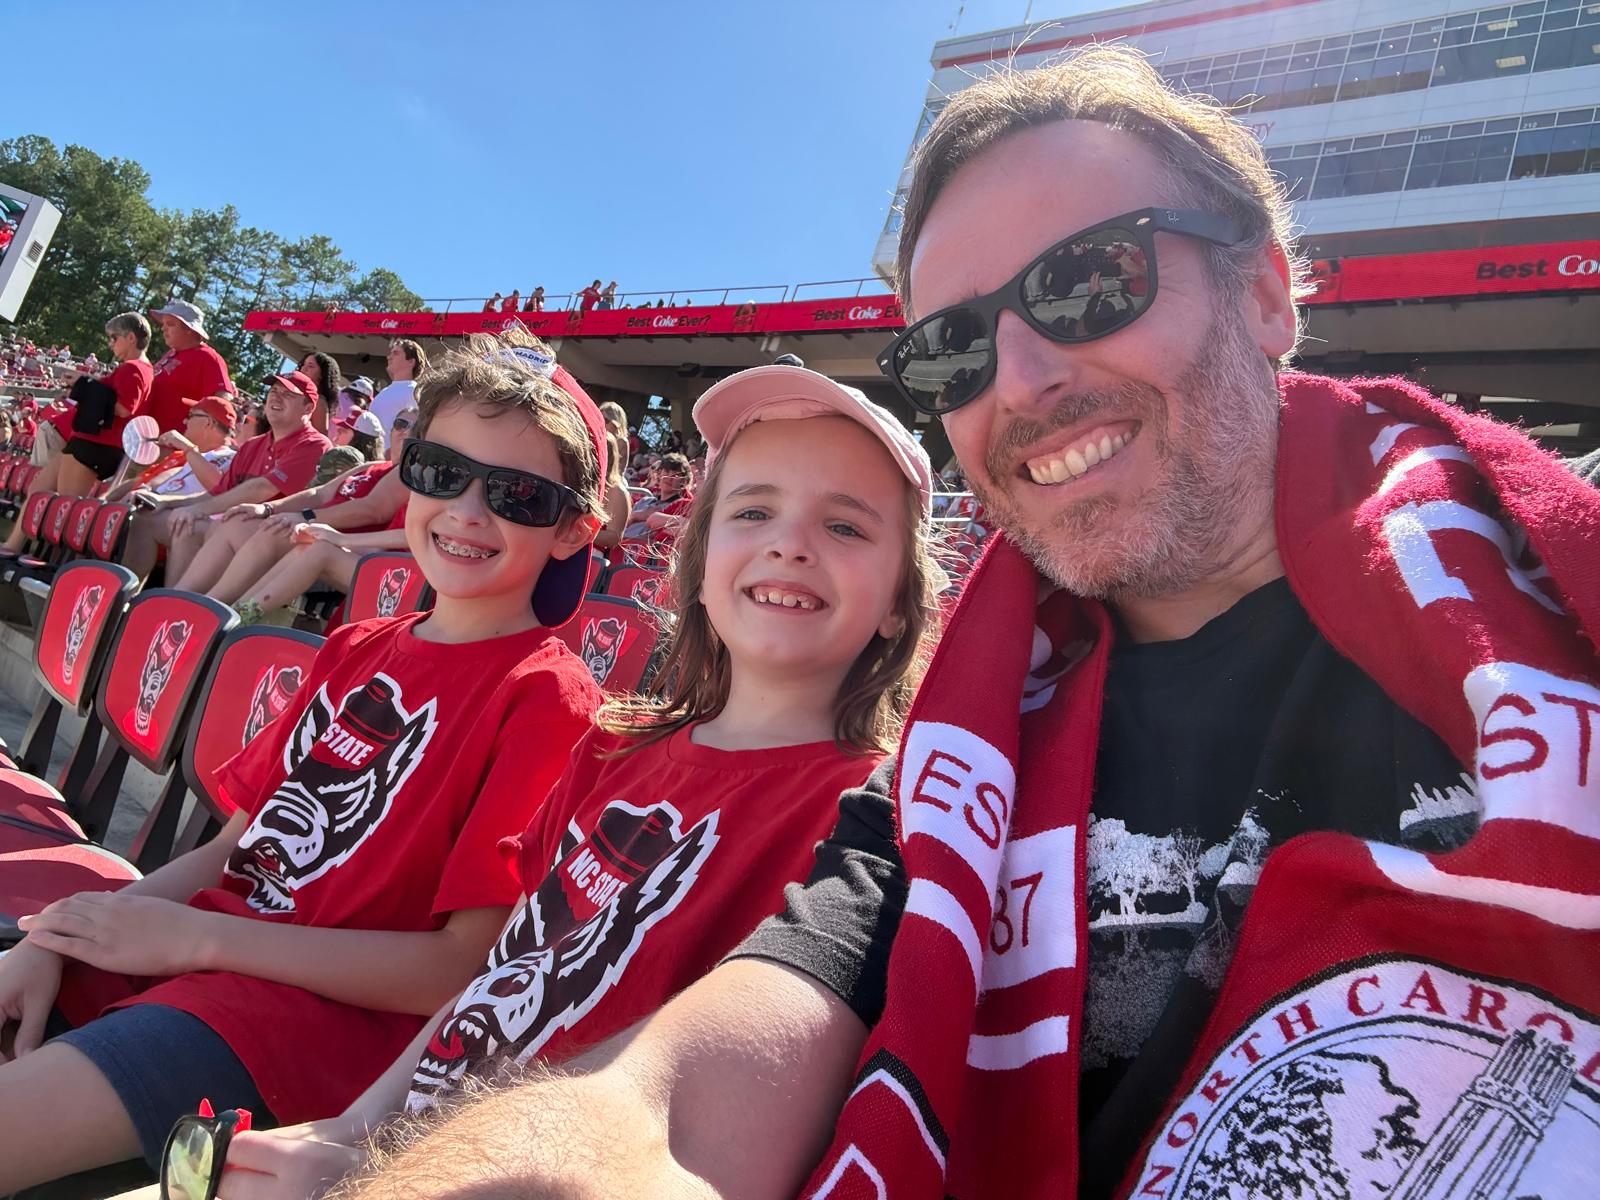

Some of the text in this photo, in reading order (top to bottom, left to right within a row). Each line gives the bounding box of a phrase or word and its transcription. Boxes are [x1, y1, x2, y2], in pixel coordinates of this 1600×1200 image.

[1477, 254, 1600, 280] Best Co
[481, 319, 500, 329] Best
[626, 314, 711, 328] Best Coke Ever?
[814, 308, 846, 321] Best
[848, 306, 882, 321] Coke
[320, 722, 375, 766] STATE
[567, 847, 629, 908] NC STAT
[1139, 998, 1324, 1199] NORTH
